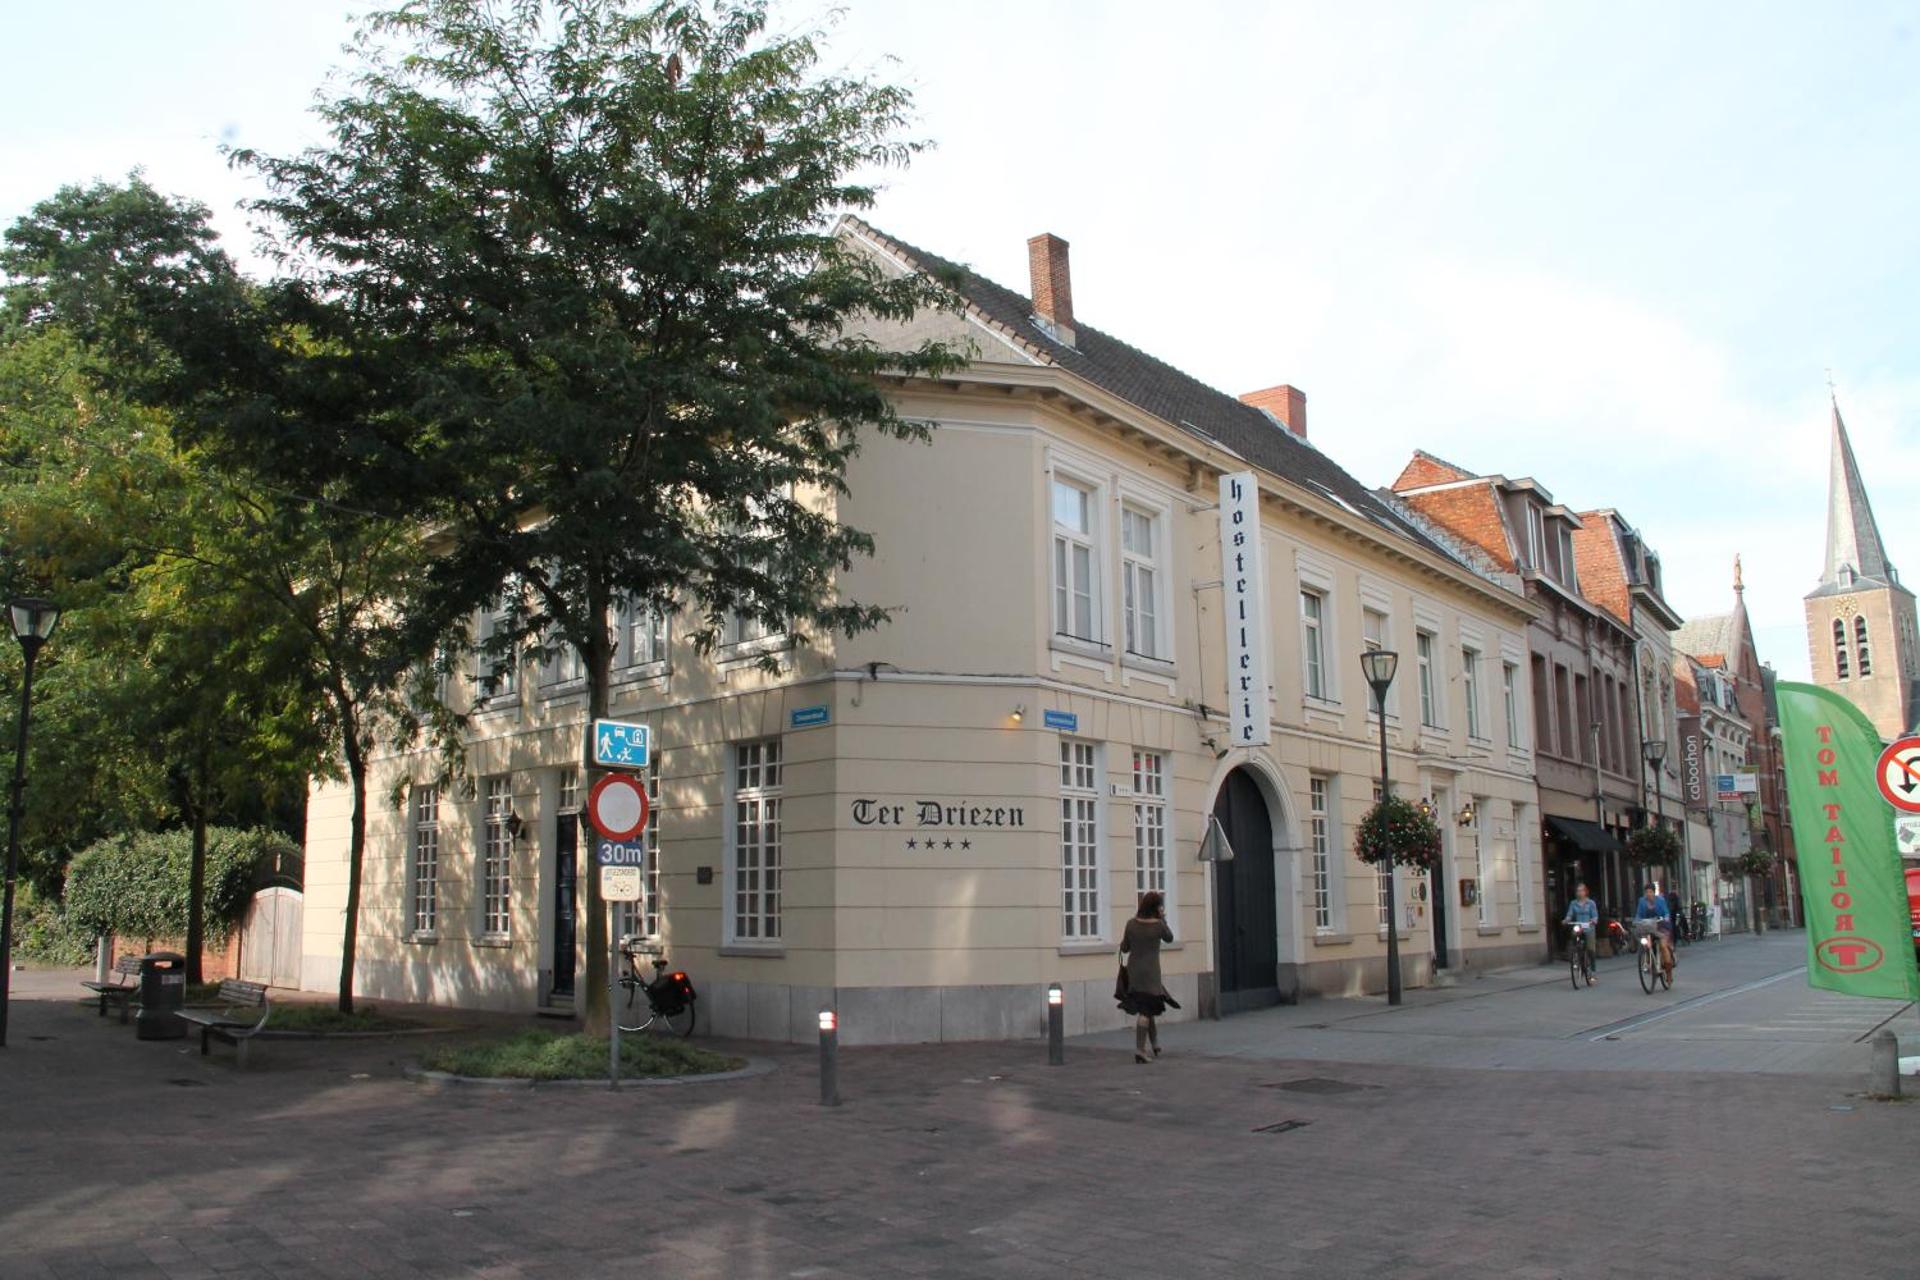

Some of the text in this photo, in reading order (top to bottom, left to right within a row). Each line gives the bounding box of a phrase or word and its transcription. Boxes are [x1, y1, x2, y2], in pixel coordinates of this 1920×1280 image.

[1230, 479, 1254, 741] hostellerie
[1684, 735, 1701, 800] cabochon
[851, 799, 1024, 827] Ter Driezen
[601, 843, 642, 863] 30m
